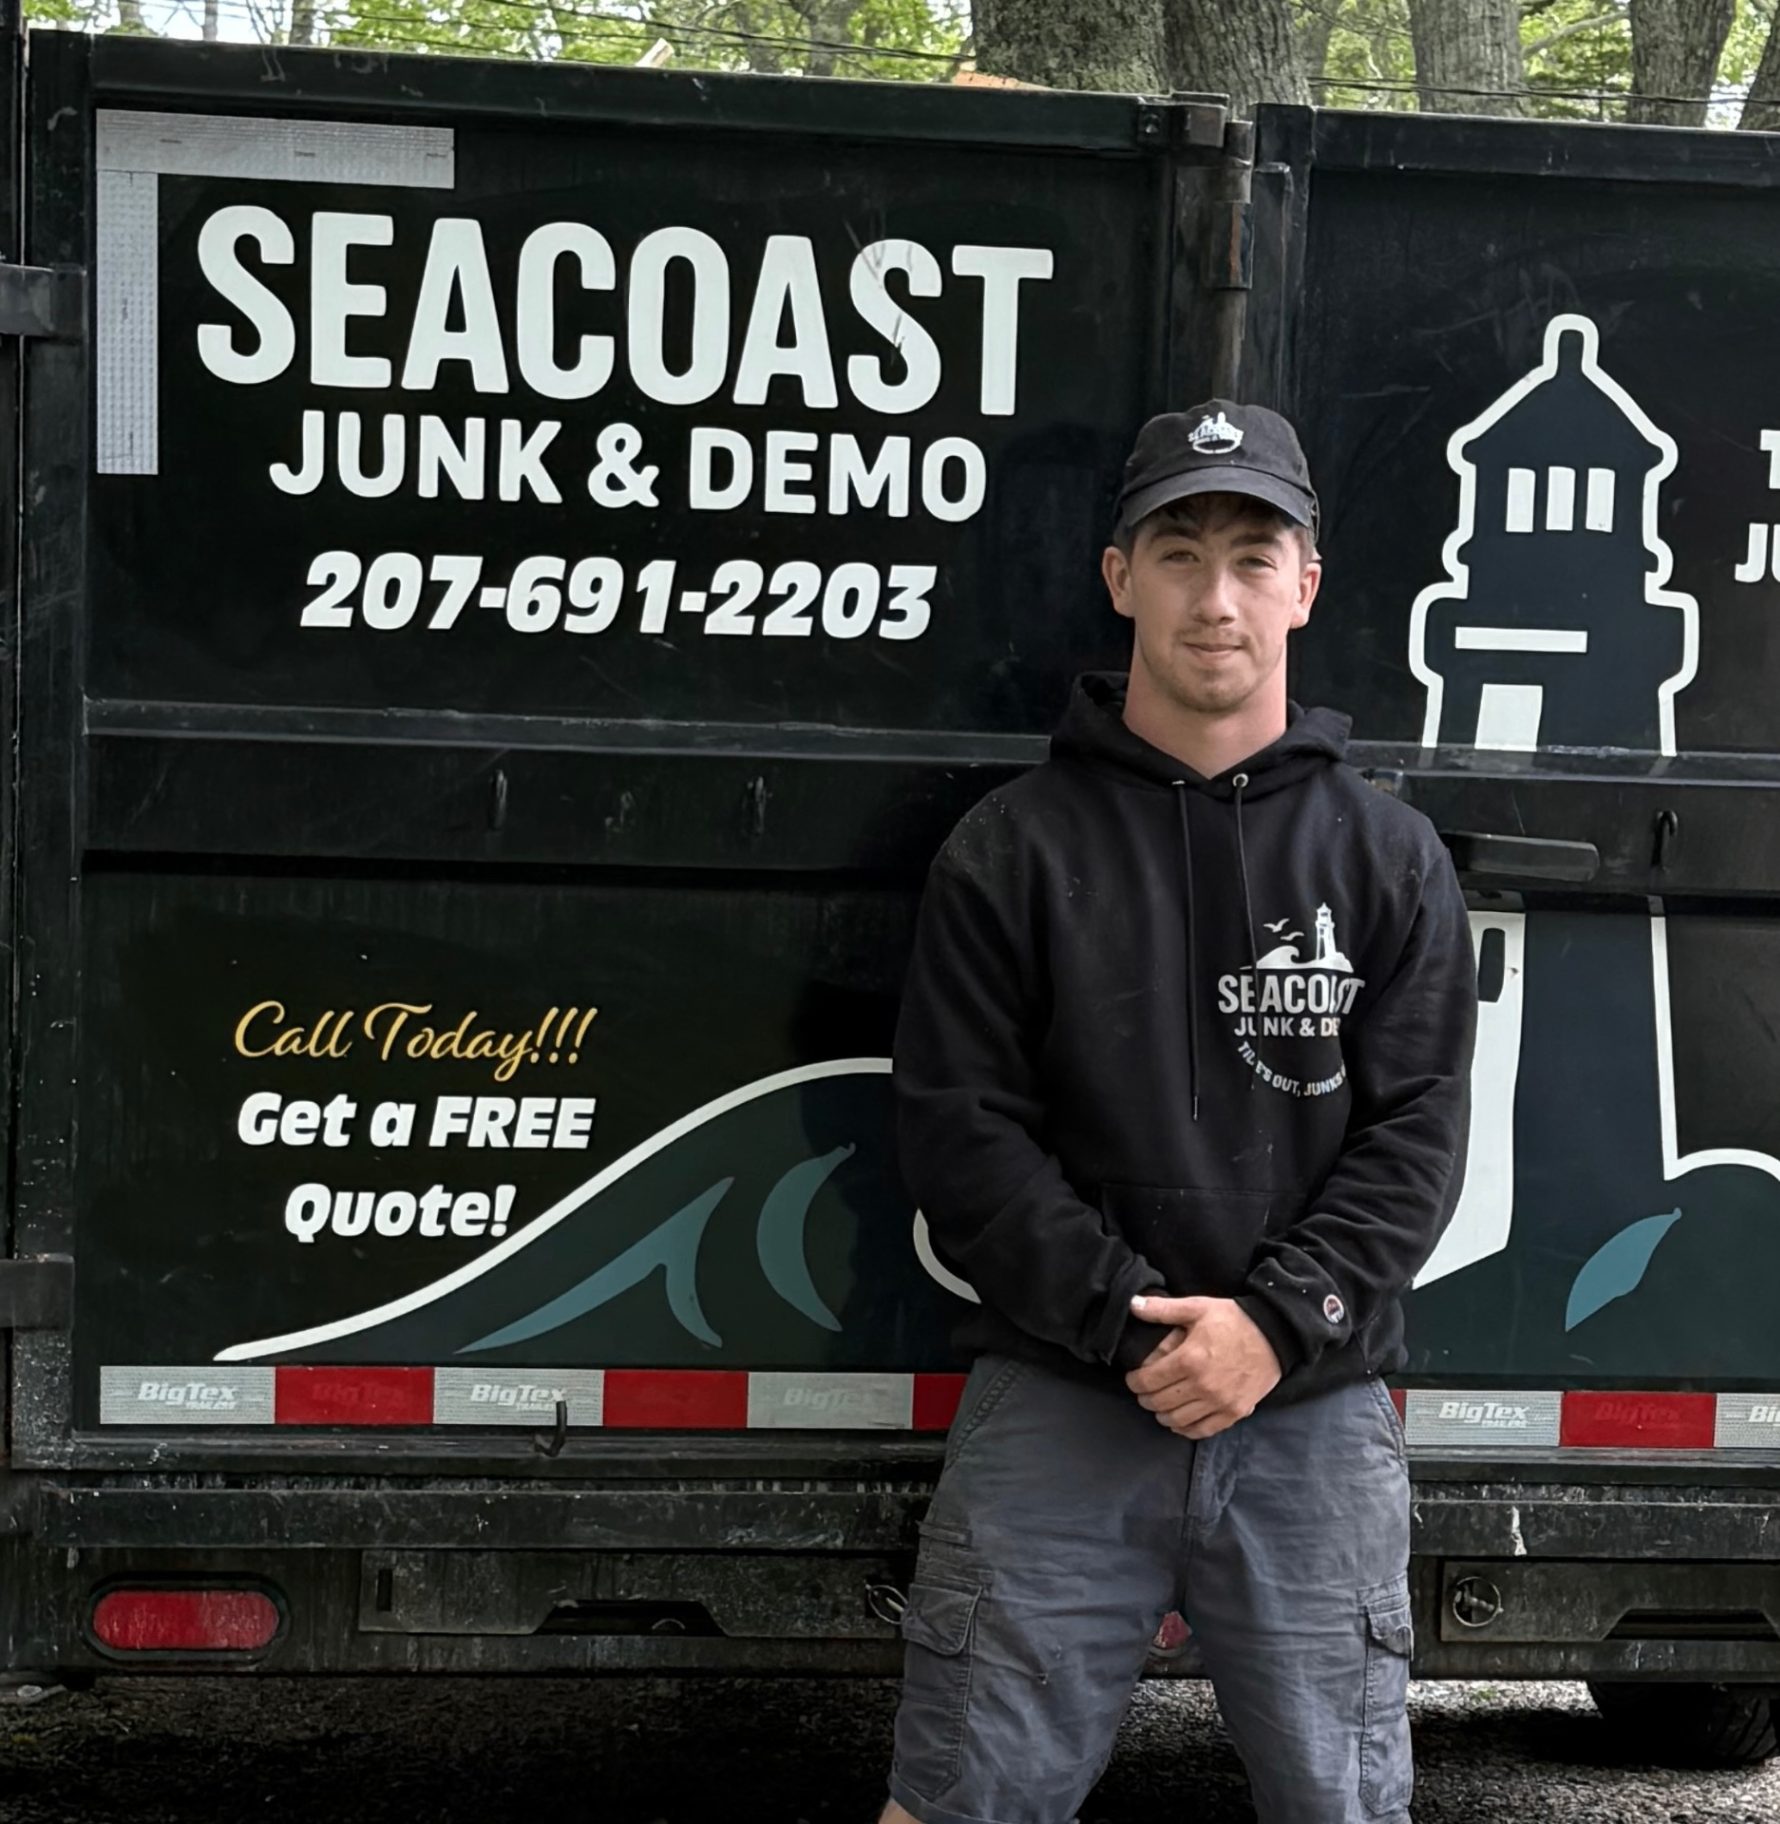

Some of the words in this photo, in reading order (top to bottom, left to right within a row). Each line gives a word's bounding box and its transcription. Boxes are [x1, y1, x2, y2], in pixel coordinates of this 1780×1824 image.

[198, 206, 1053, 416] SEACOAST
[270, 410, 562, 503] JUNK
[588, 423, 660, 508] &
[690, 427, 986, 522] DEMO
[300, 551, 937, 640] 207-691-2203
[235, 1000, 354, 1058] Call
[364, 1002, 598, 1082] Today!!!
[1299, 1017, 1315, 1037] &
[237, 1091, 357, 1147] Get
[370, 1102, 416, 1147] a
[429, 1096, 596, 1149] FREE
[285, 1183, 516, 1243] Quote!
[139, 1382, 239, 1406] BigTex
[470, 1384, 567, 1406] BigTex
[1439, 1401, 1530, 1424] BigTex
